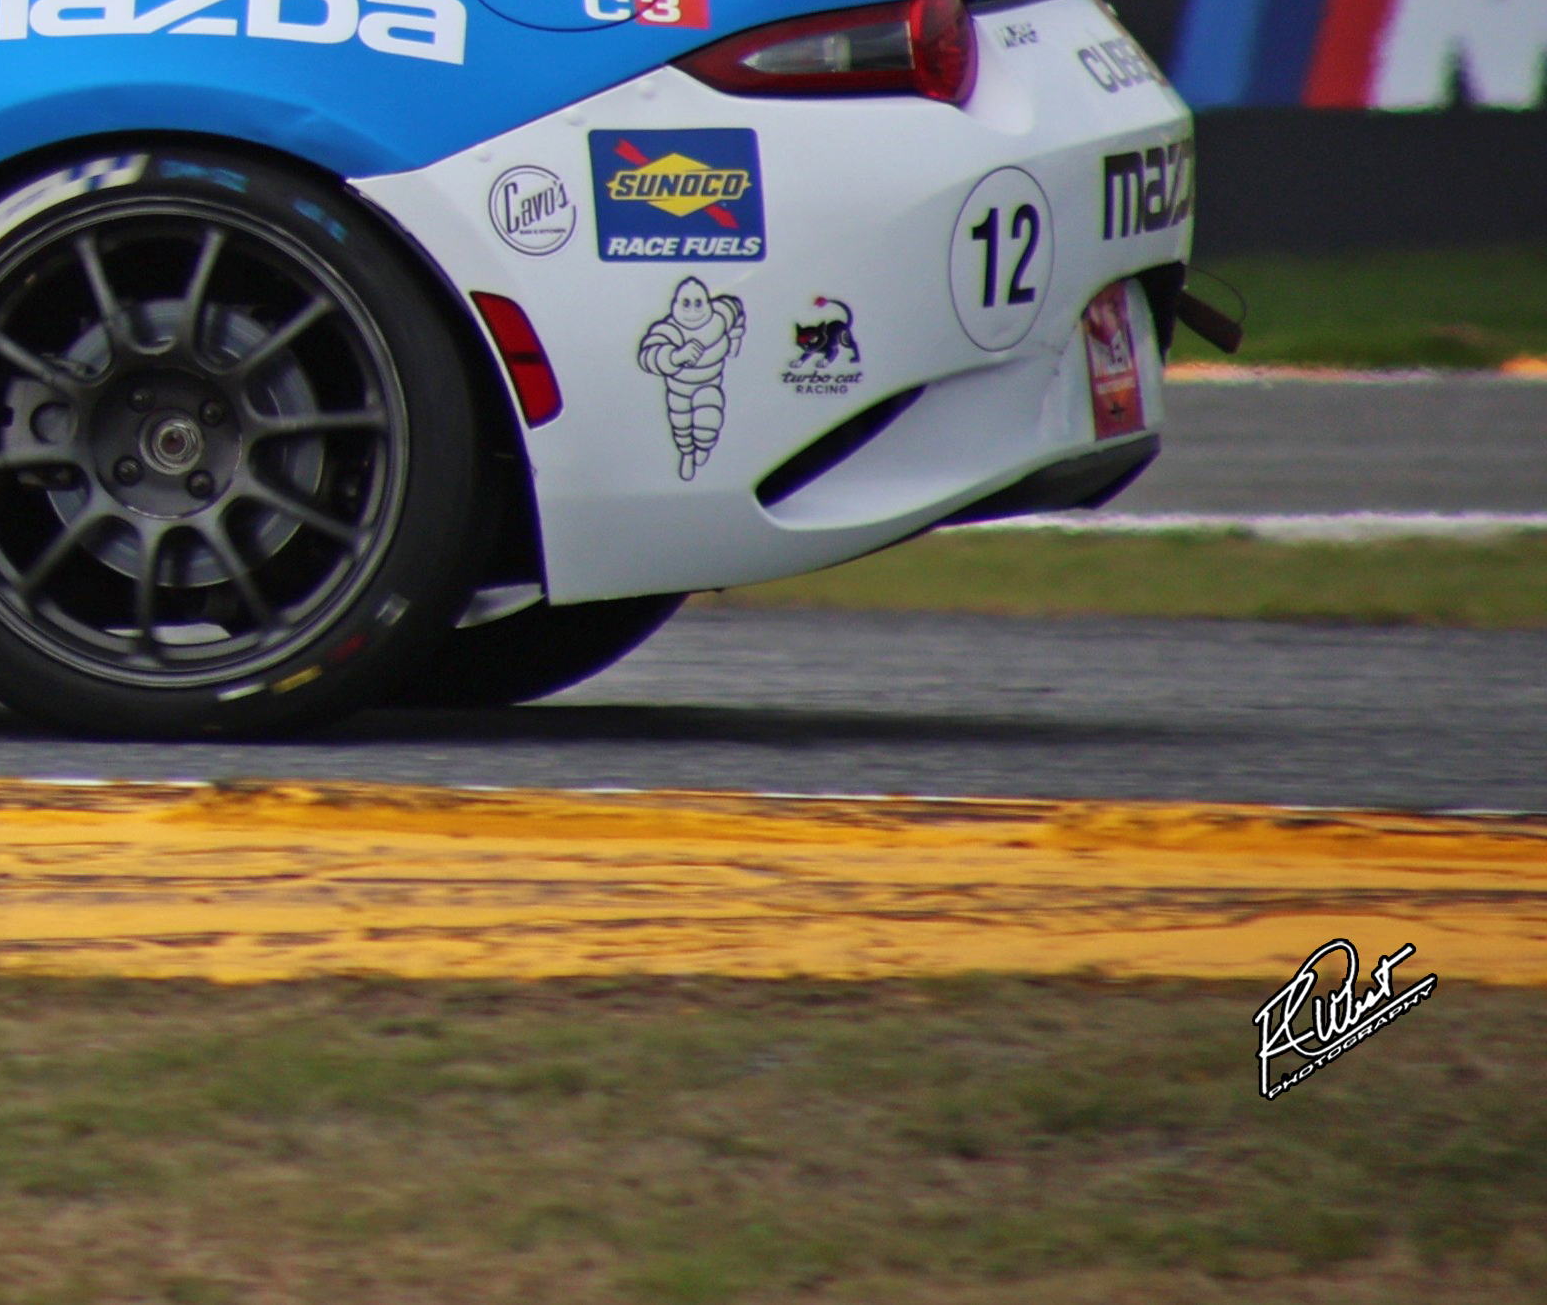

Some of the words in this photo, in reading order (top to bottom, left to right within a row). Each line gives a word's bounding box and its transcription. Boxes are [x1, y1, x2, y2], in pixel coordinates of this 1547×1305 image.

[613, 173, 745, 198] SUNOCO
[504, 179, 570, 234] Cavo's
[608, 238, 677, 256] RACE
[682, 237, 762, 256] FUELS
[971, 203, 1038, 309] 12
[795, 385, 849, 394] RACING
